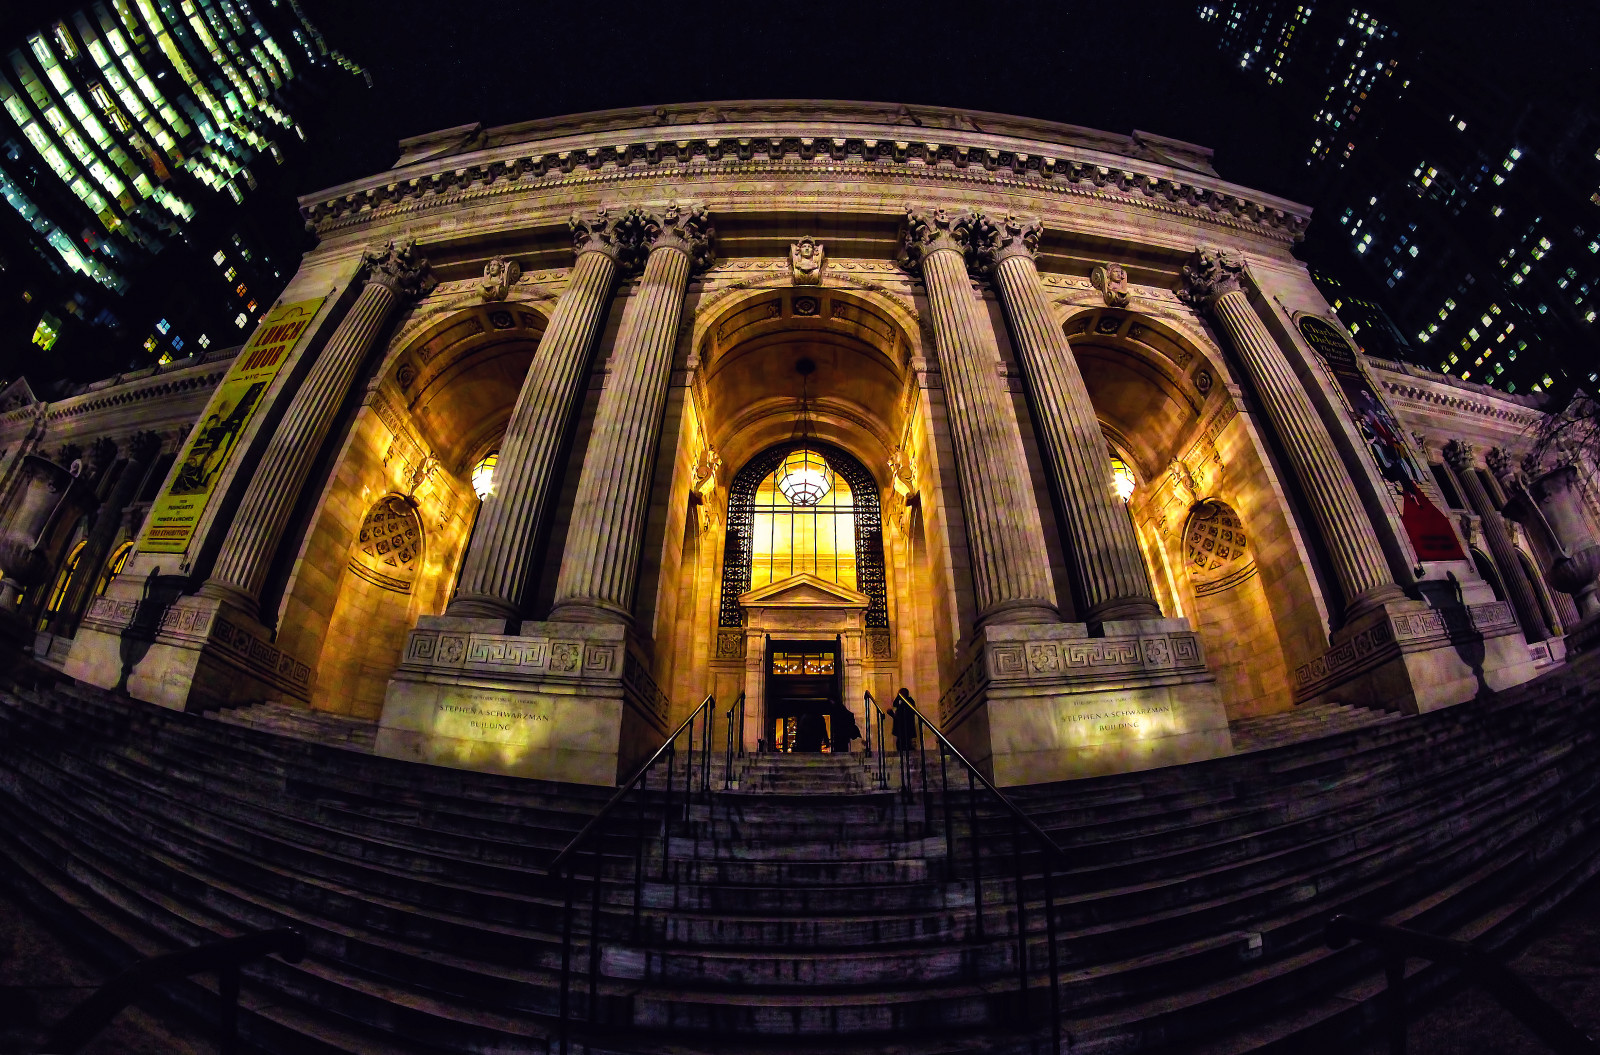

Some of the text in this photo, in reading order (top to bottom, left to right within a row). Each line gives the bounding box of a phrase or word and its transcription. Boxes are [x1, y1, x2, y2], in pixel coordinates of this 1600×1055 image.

[254, 320, 307, 347] LUNCH
[1303, 323, 1341, 338] Charles
[1310, 333, 1348, 349] Dickens
[241, 345, 286, 372] HOUR
[439, 705, 476, 715] STEPHEN
[486, 710, 549, 721] SCHWARZMAN
[1061, 713, 1102, 722] STEPHEN
[1111, 706, 1170, 718] SCHWARZMAN
[470, 721, 511, 731] BUILDING
[1099, 722, 1140, 731] BUILDING
